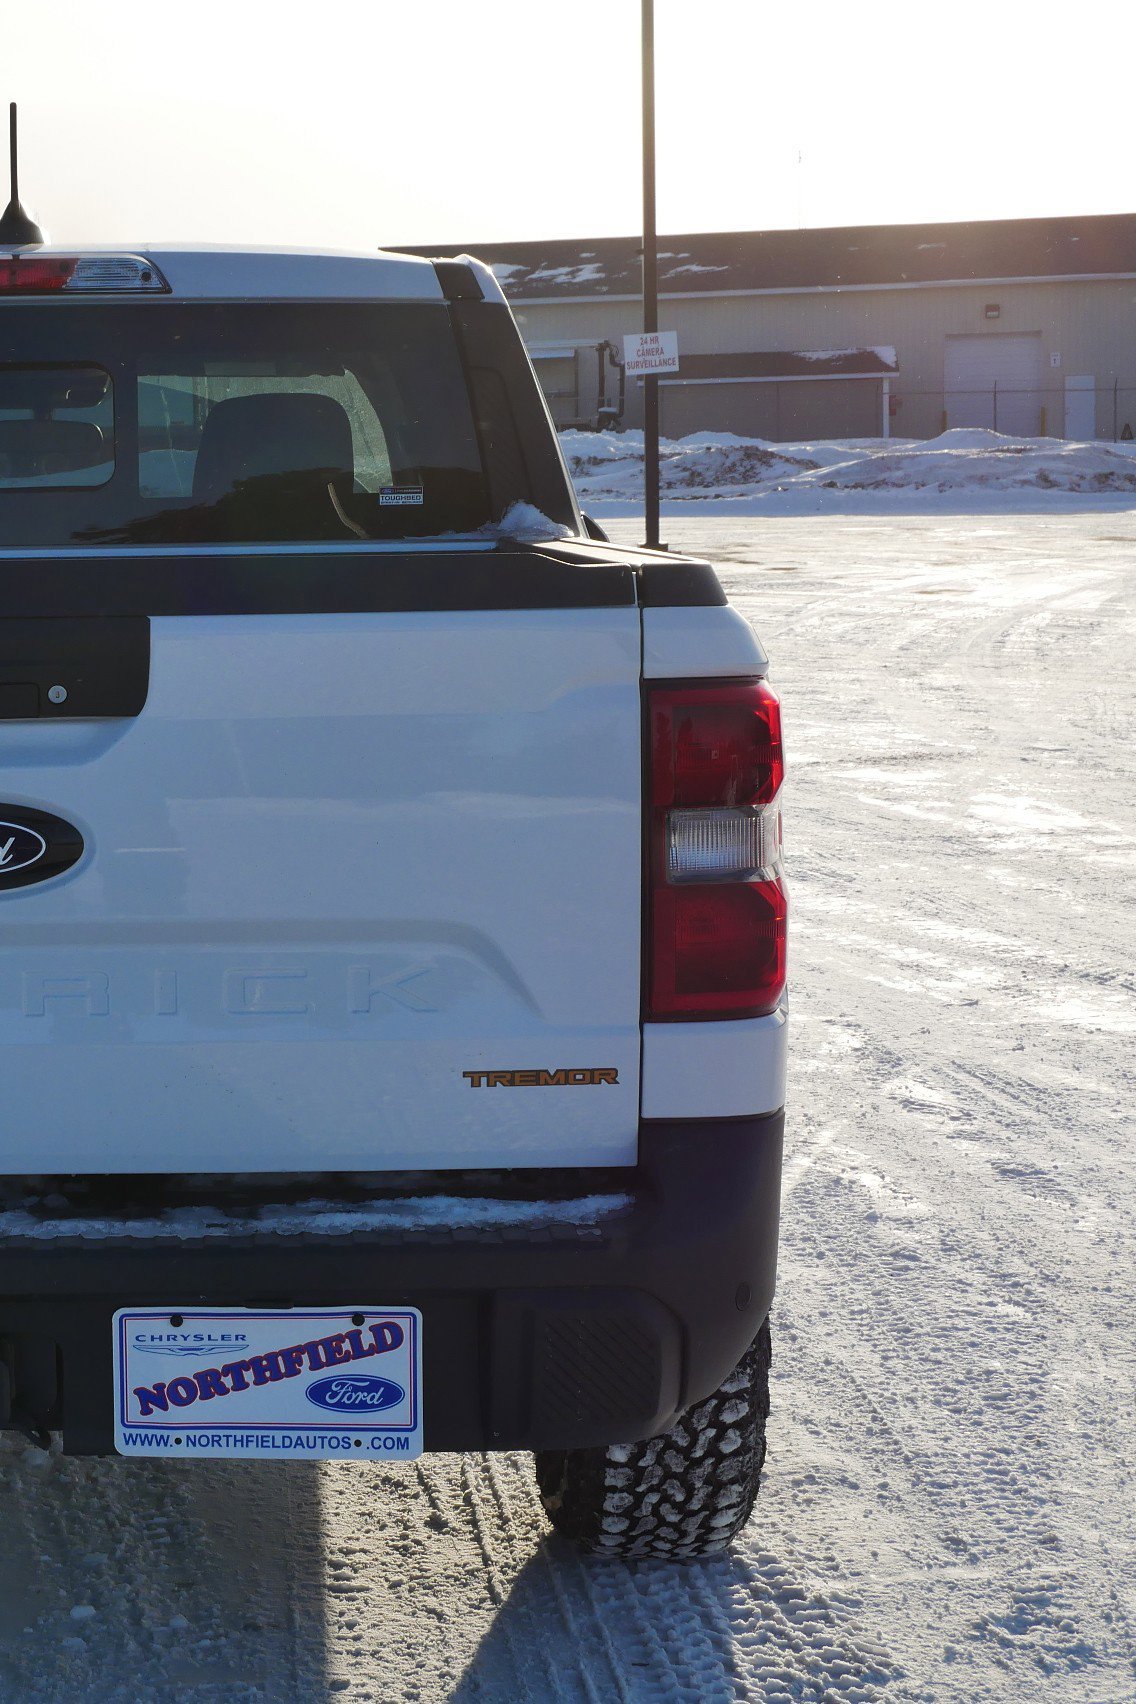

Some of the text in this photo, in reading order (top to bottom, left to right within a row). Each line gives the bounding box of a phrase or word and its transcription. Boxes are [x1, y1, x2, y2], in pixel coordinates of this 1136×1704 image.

[640, 336, 660, 345] 24 HR
[636, 347, 665, 357] CAMERA
[626, 357, 677, 370] SURVEILLANCE
[463, 1068, 620, 1088] TREMOR
[134, 1333, 247, 1342] CHRYSLER
[132, 1320, 406, 1417] NORTHFIELD
[325, 1380, 384, 1405] Ford
[185, 1434, 352, 1450] NORTHFIELDAUTOS
